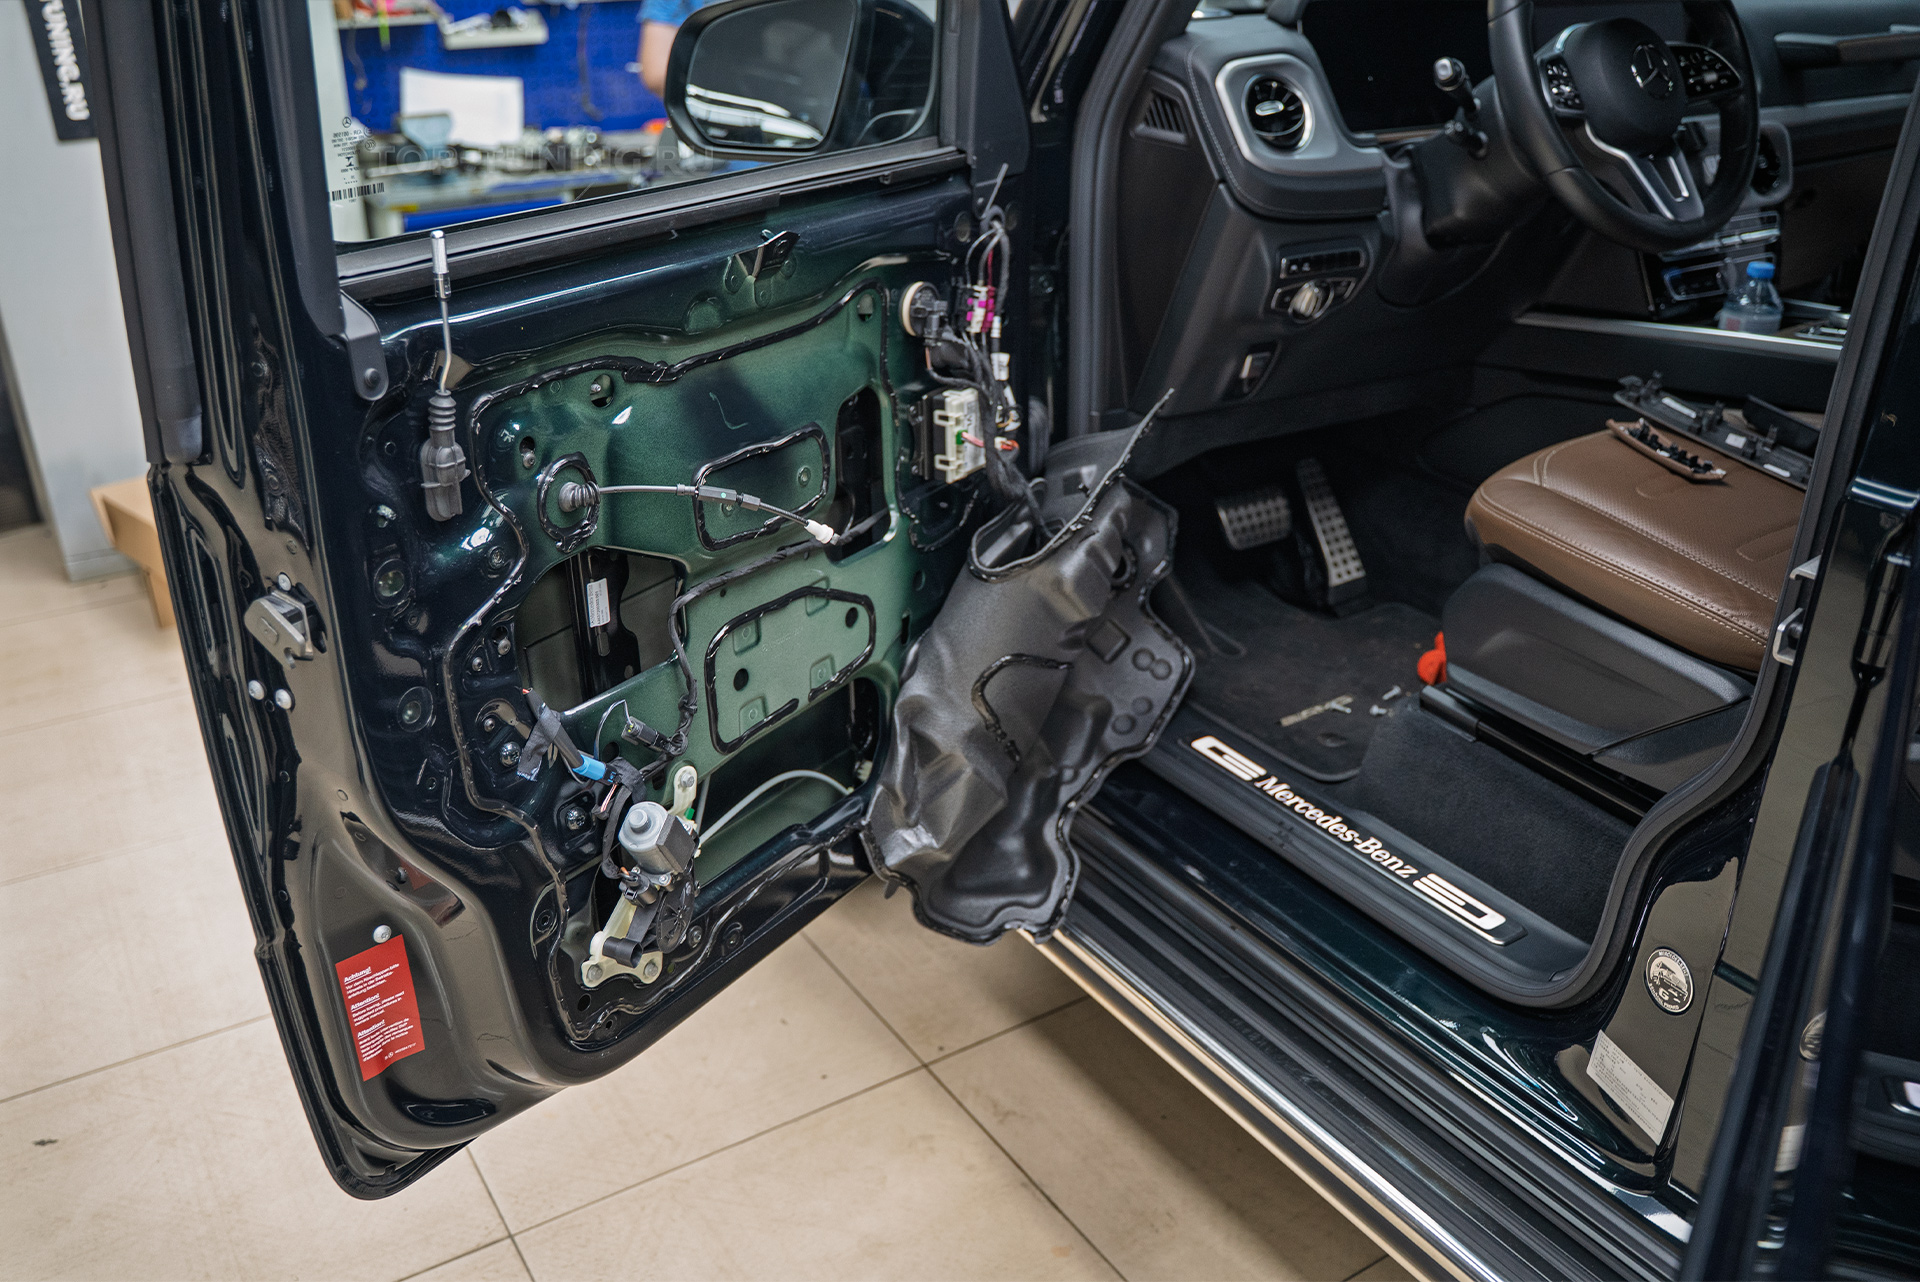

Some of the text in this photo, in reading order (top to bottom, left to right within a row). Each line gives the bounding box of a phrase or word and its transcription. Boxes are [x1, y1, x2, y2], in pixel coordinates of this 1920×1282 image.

[39, 0, 90, 120] UNING.RU
[1254, 775, 1419, 880] Mercedes-Benz
[351, 993, 380, 1010] Attention!
